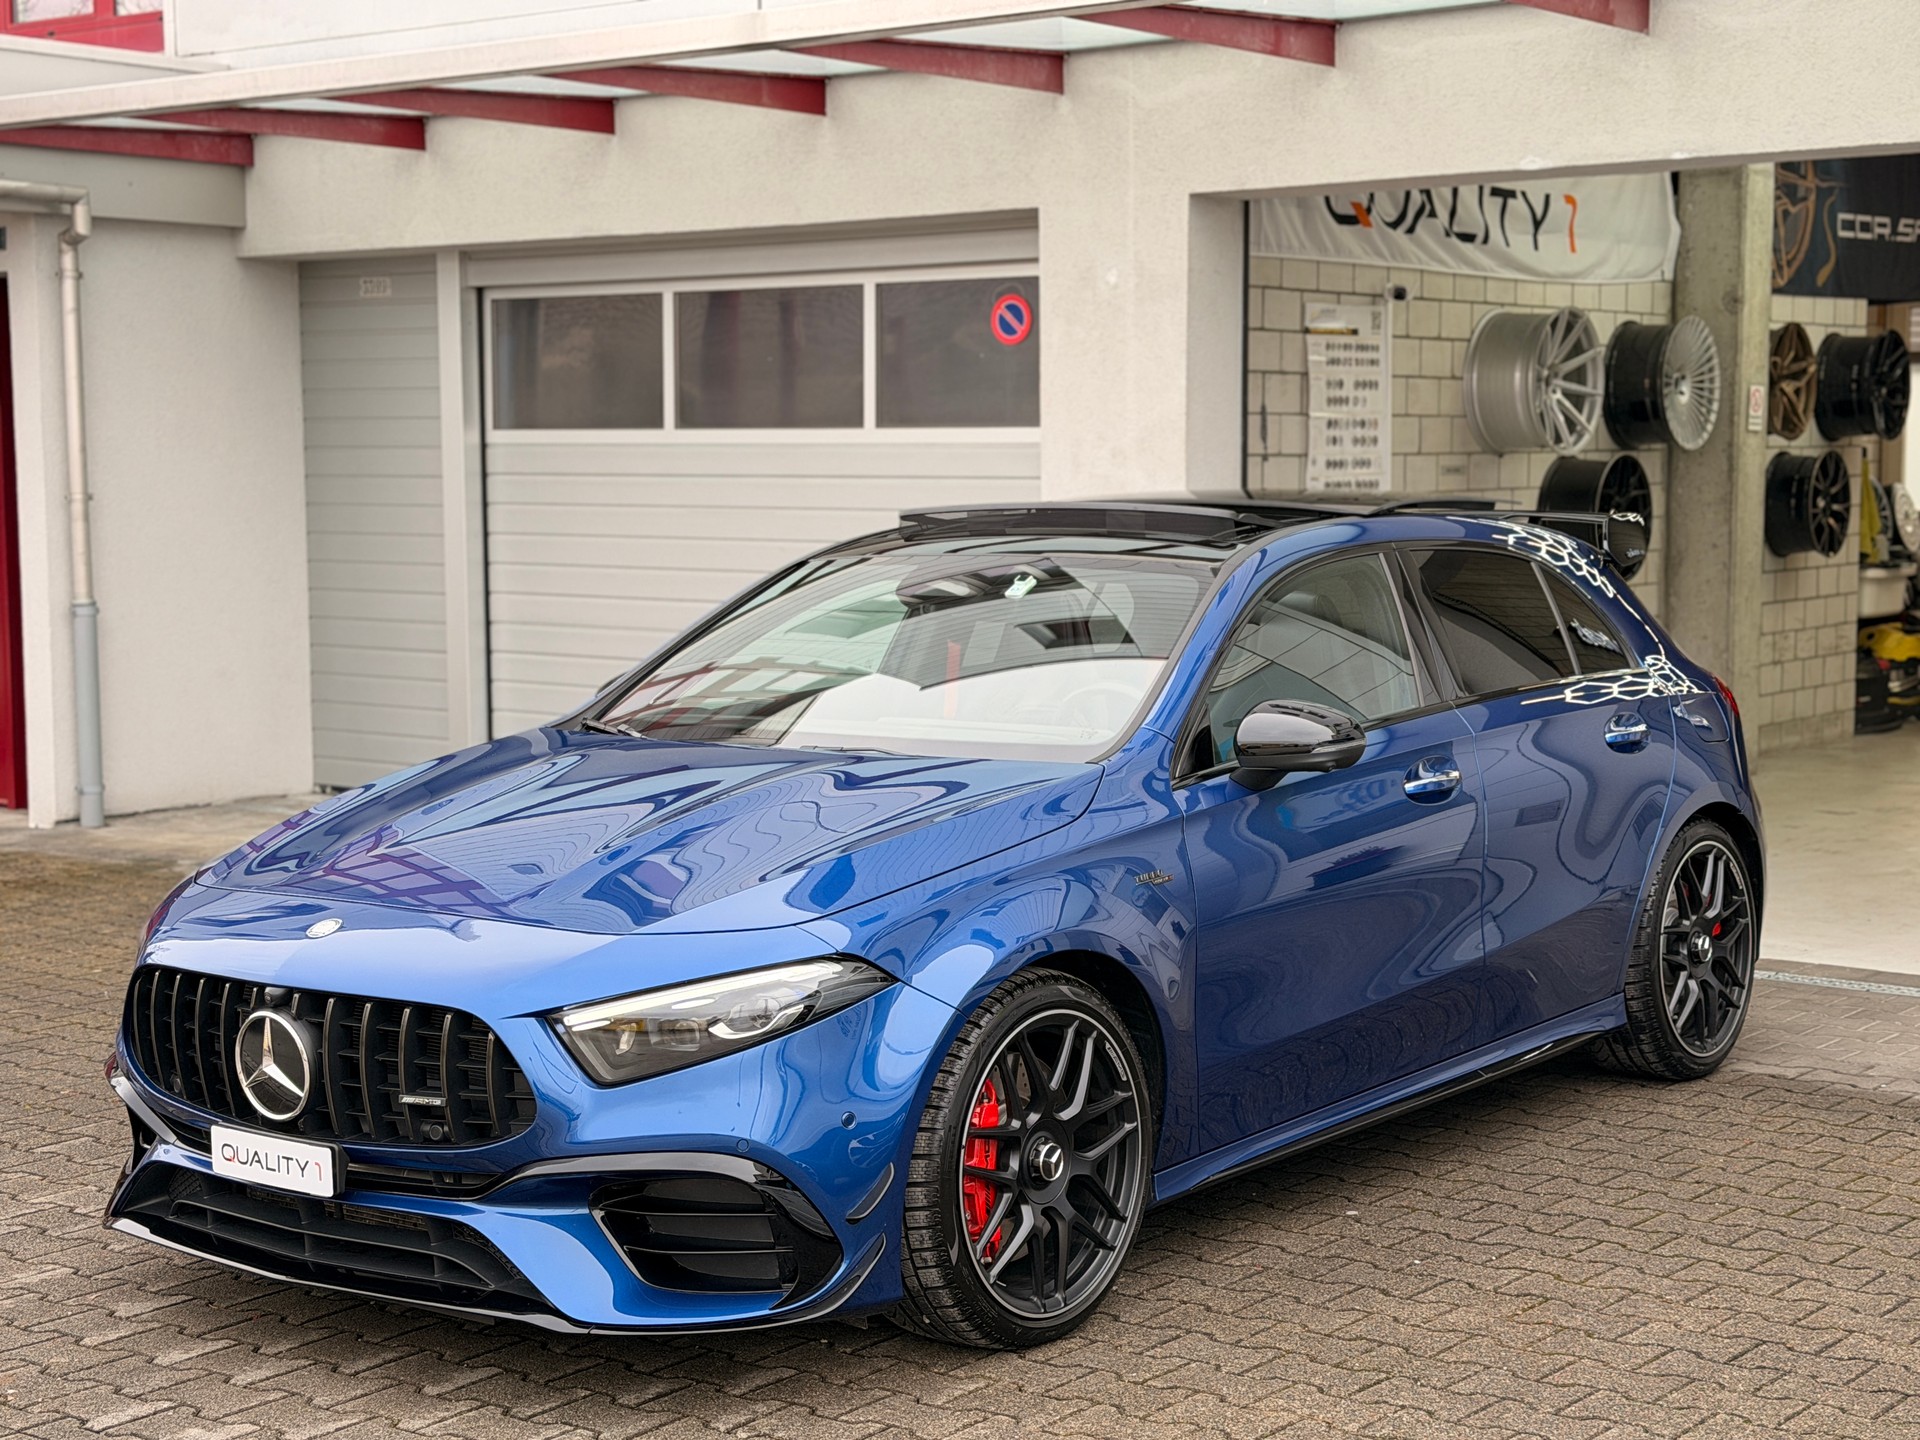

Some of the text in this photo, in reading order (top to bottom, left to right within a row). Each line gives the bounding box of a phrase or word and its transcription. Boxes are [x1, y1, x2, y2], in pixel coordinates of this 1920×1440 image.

[1564, 194, 1577, 253] 1
[221, 1143, 322, 1181] QUALITY 1
